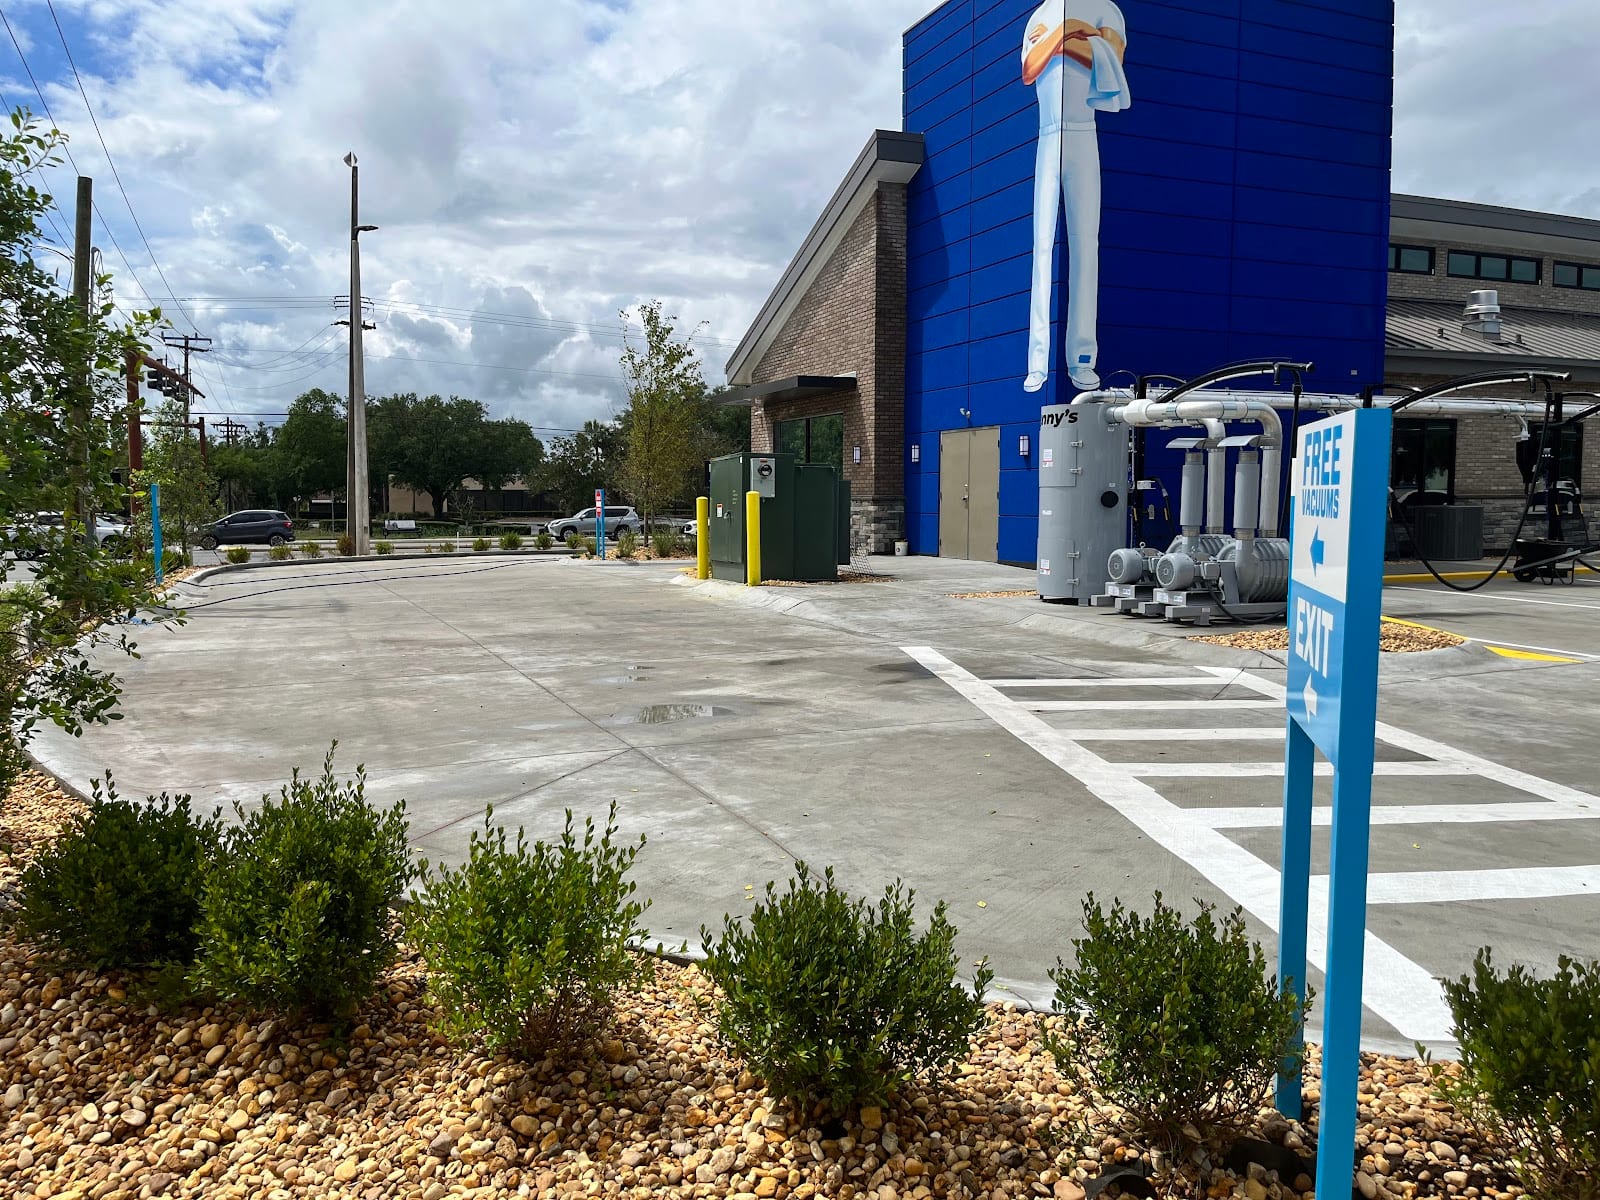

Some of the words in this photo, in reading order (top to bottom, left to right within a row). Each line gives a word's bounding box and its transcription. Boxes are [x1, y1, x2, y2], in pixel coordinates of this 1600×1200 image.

[1303, 425, 1343, 486] FREE
[1302, 489, 1339, 519] VACUUMS
[1295, 597, 1334, 678] EXIT
